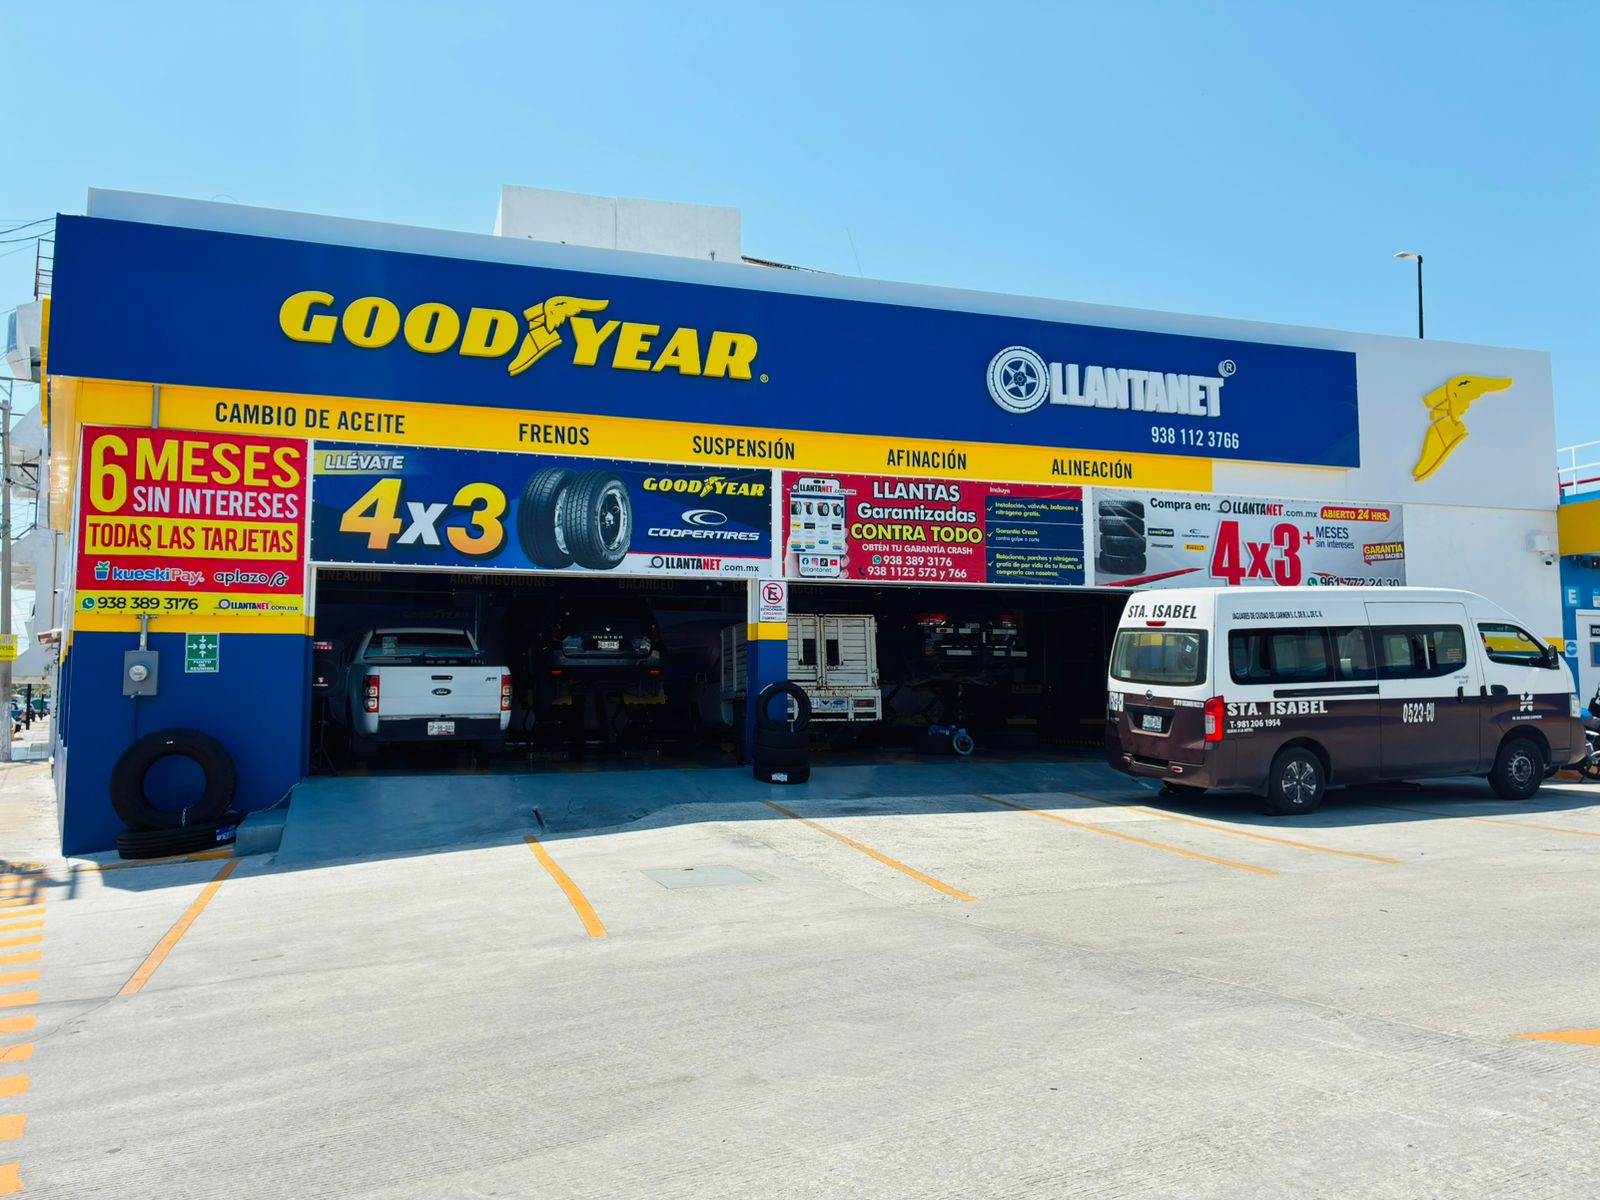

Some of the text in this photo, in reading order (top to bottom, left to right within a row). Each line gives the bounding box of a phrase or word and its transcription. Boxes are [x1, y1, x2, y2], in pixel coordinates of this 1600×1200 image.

[279, 290, 758, 380] GOODYEAR
[215, 402, 406, 434] CAMBIO DE ACEITE
[519, 423, 590, 446] FRENOS
[1151, 426, 1239, 449] 938 112 3766
[692, 435, 795, 460] SUSPENSIÓN
[325, 452, 405, 470] LLÉVATE
[887, 449, 967, 471] AFINACIÓN
[1051, 458, 1132, 480] ALINEACIÓN
[90, 434, 301, 513] 6 MESES
[643, 476, 766, 497] GOODYEAR
[873, 481, 960, 502] LLANTAS
[133, 486, 299, 519] SIN INTERESES
[857, 502, 977, 523] Garantizadas
[1150, 498, 1192, 511] Compra
[1195, 501, 1211, 511] en:
[339, 478, 507, 555] 4x3
[1322, 509, 1389, 521] ABIERTO 24 HRS.
[89, 523, 294, 553] TODAS LAS TARJETAS
[648, 528, 760, 541] COOPERTIRES
[851, 523, 983, 544] CONTRA TODO
[1316, 526, 1349, 539] MESES
[862, 542, 889, 551] OBTÉN
[904, 543, 945, 553] GARANTÍA
[947, 546, 973, 554] CRASH
[1211, 520, 1301, 586] 4x3
[1316, 540, 1354, 549] sin intereses
[883, 556, 953, 567] 938 389 3176
[214, 569, 269, 586] aplazo
[867, 566, 967, 579] 938 1123 573 y 766
[97, 596, 127, 610] 938
[130, 597, 160, 610] 389
[164, 598, 199, 611] 3176
[1127, 604, 1198, 620] STA. ISABEL
[1227, 700, 1329, 717] STA. ISABEL
[1402, 702, 1435, 724] 0523-CU
[1250, 719, 1264, 728] 206
[1265, 718, 1281, 728] 1954
